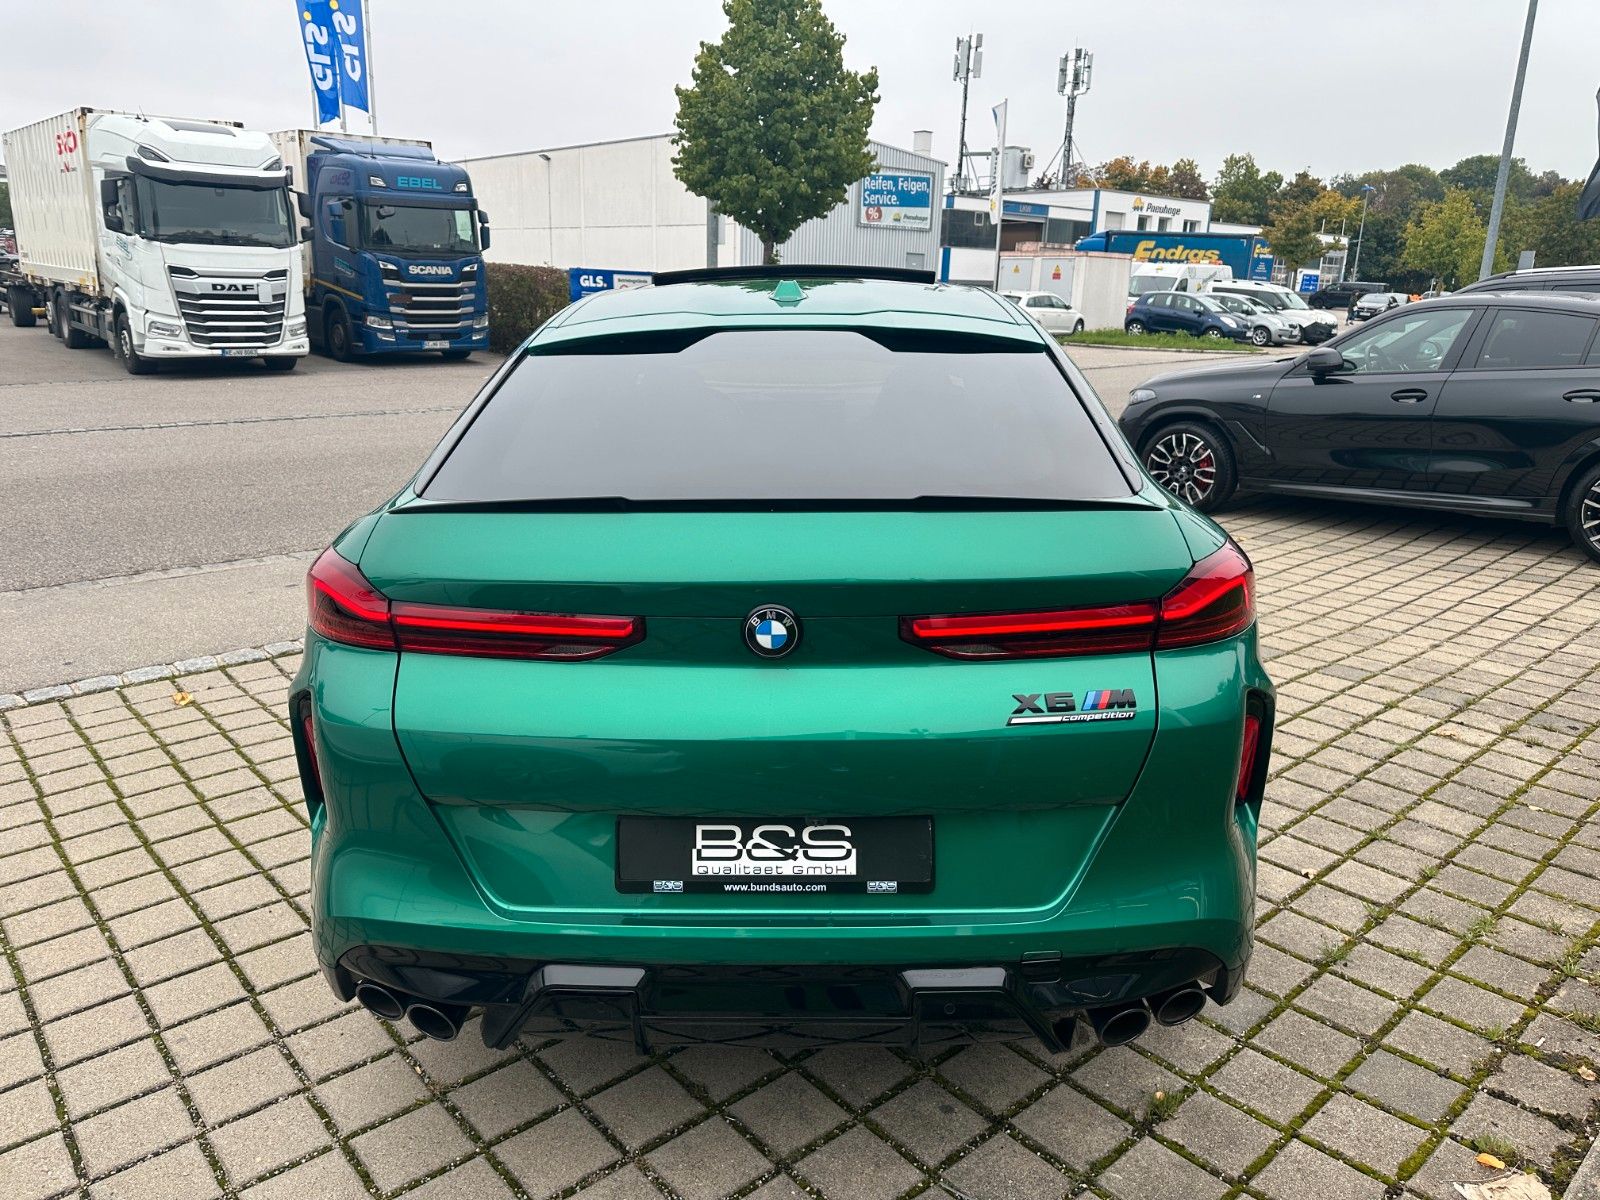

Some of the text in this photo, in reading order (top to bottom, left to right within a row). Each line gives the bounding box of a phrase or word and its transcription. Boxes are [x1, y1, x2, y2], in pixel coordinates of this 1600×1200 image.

[397, 176, 442, 189] EBEL
[864, 176, 930, 195] Reifen, Felgen,
[864, 191, 899, 205] Service.
[1134, 240, 1220, 263] Endras
[409, 265, 453, 275] SCANIA
[211, 283, 255, 291] DAF
[750, 610, 793, 627] BMW
[1011, 692, 1076, 714] X6
[1061, 711, 1135, 723] competition
[696, 824, 853, 862] B&S
[696, 864, 784, 876] Qualitaet
[654, 880, 683, 891] B&S
[724, 882, 827, 893] www.bundsauto.com
